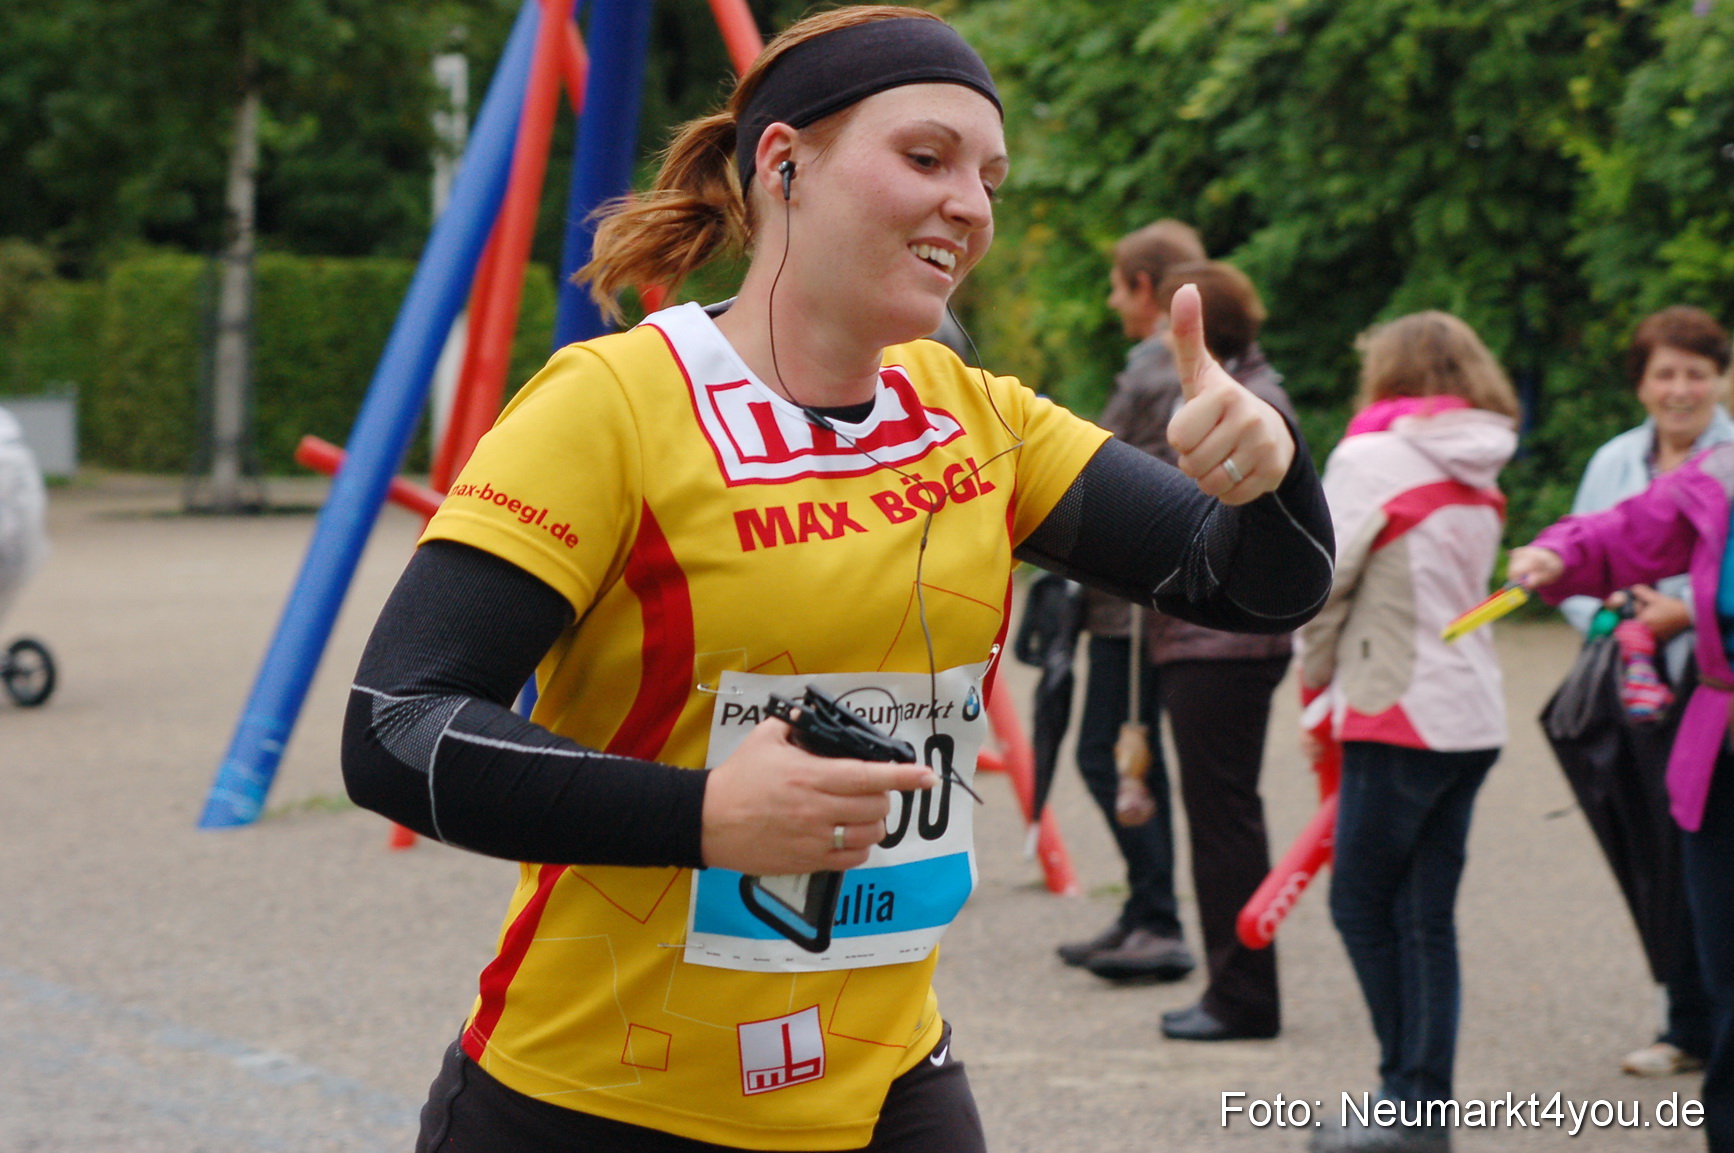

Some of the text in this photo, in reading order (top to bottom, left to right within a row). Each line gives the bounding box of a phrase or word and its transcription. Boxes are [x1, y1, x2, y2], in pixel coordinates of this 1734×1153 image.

[733, 457, 996, 552] MAX BÖGL
[845, 697, 954, 725] eumarkt
[831, 882, 895, 928] ulia
